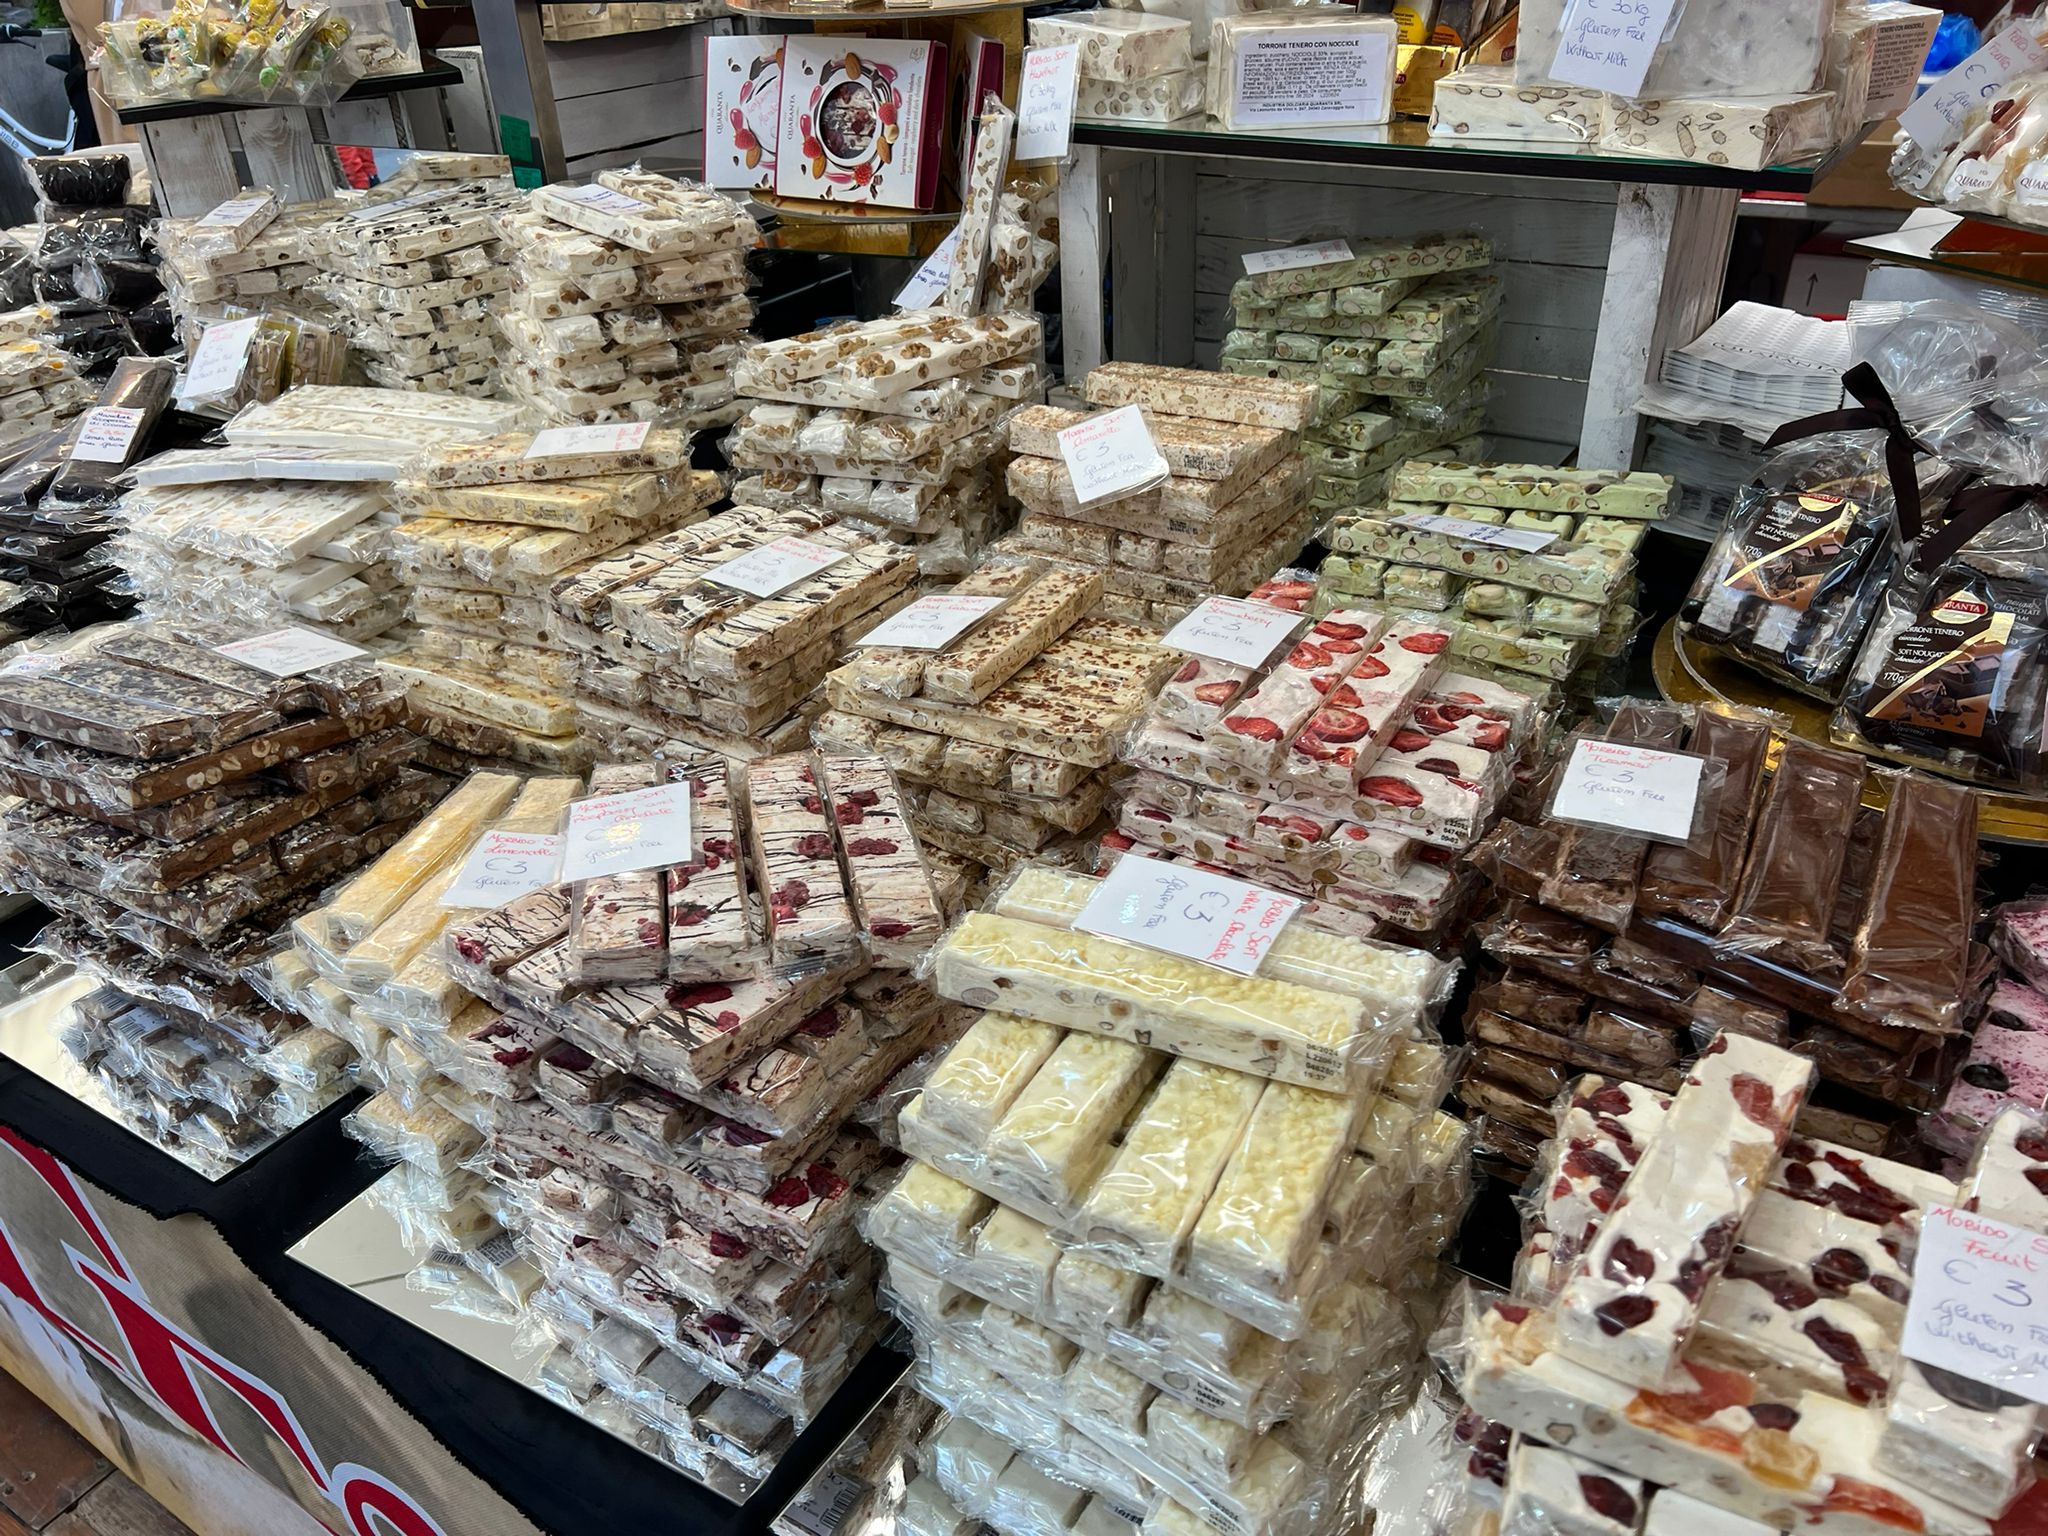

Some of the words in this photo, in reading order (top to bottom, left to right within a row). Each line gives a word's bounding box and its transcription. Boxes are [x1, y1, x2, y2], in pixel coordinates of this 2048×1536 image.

[716, 90, 725, 134] QUARANTA
[786, 94, 796, 140] QUARANTA
[2020, 177, 2048, 191] QUAR
[1798, 513, 1822, 525] TENERO
[1744, 545, 1763, 558] 170g
[1993, 602, 2042, 616] CHOCOLATE
[1933, 627, 1965, 637] TENERO
[1898, 648, 1913, 656] SOFT
[1883, 672, 1905, 684] 170g
[1585, 764, 1603, 777] €
[1612, 770, 1634, 784] 3
[504, 861, 528, 875] 3
[1200, 891, 1230, 908] €
[1184, 904, 1214, 923] 3
[1963, 1237, 2039, 1272] Fruit
[1943, 1258, 1977, 1285] €
[1992, 1280, 2032, 1307] 3
